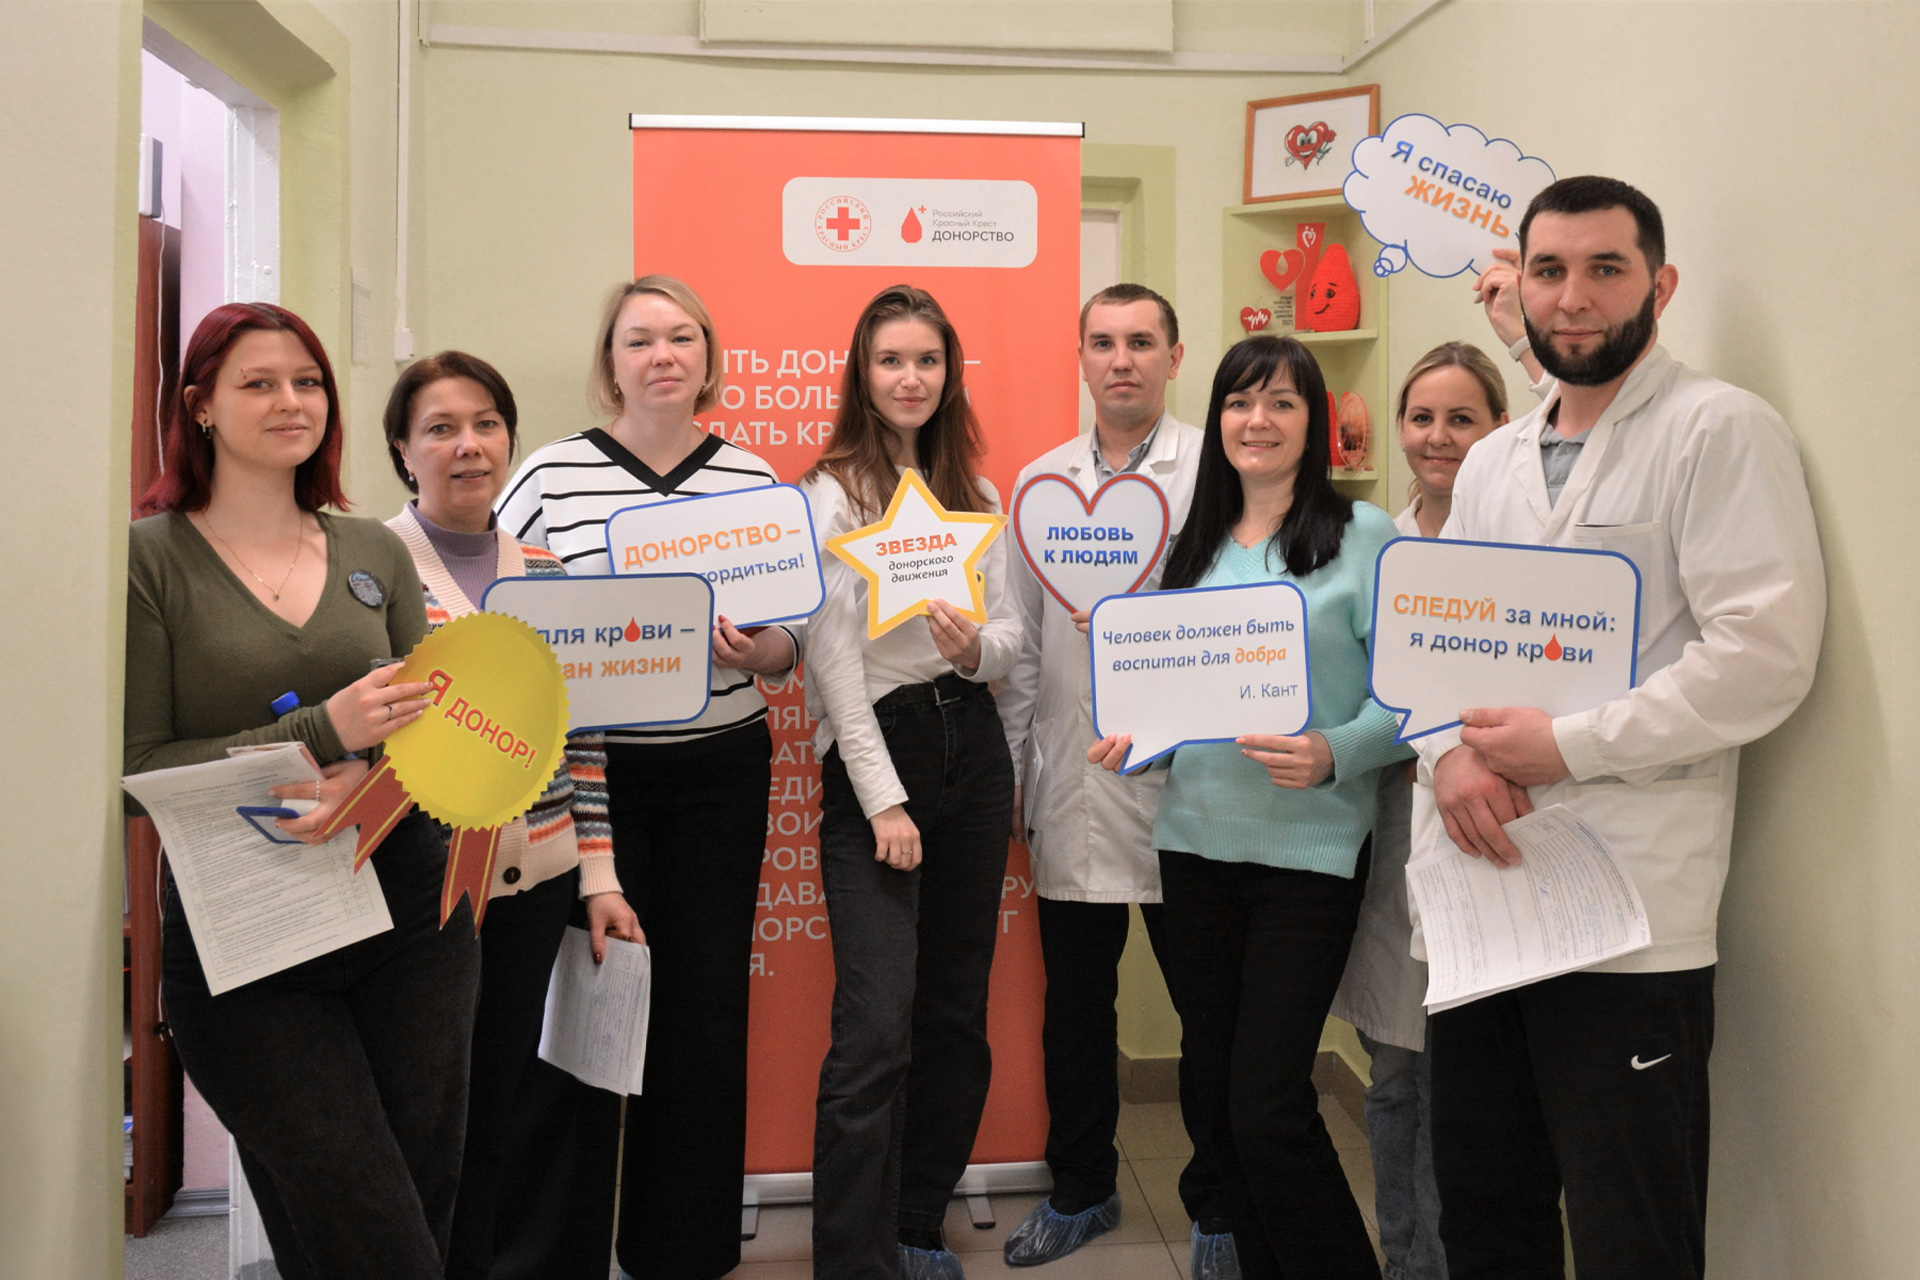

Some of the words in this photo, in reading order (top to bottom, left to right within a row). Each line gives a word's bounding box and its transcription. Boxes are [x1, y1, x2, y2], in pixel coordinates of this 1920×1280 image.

[1391, 140, 1415, 163] Я
[1418, 156, 1512, 210] спасаю
[932, 209, 983, 218] Российский
[932, 218, 970, 228] Красный
[972, 219, 998, 229] Крест
[932, 230, 1015, 243] ДОНОРСТВО
[755, 385, 842, 410] БОЛЬ
[624, 522, 782, 568] ДОНОРСТВО
[876, 532, 958, 557] ЗВЕЗДА
[1047, 526, 1134, 542] ЛЮБОВЬ
[888, 553, 954, 572] донорского
[1044, 549, 1056, 564] К
[1061, 549, 1139, 566] ЛЮДЯМ
[891, 567, 948, 584] движения
[1394, 593, 1496, 623] СЛЕДУЙ
[1505, 608, 1531, 625] за
[1541, 610, 1616, 632] мной:
[1102, 628, 1172, 645] Человек
[1175, 622, 1242, 640] должен
[1246, 618, 1295, 635] быть
[1409, 632, 1424, 647] я
[1431, 634, 1508, 659] донор
[563, 661, 593, 679] ан
[601, 656, 682, 678] жизни
[1112, 653, 1196, 672] воспитан
[1200, 650, 1231, 666] для
[1235, 645, 1287, 666] добра
[420, 669, 453, 707] Я
[1239, 684, 1256, 700] И.
[1260, 682, 1298, 698] Кант
[444, 697, 537, 769] ДОНОР!
